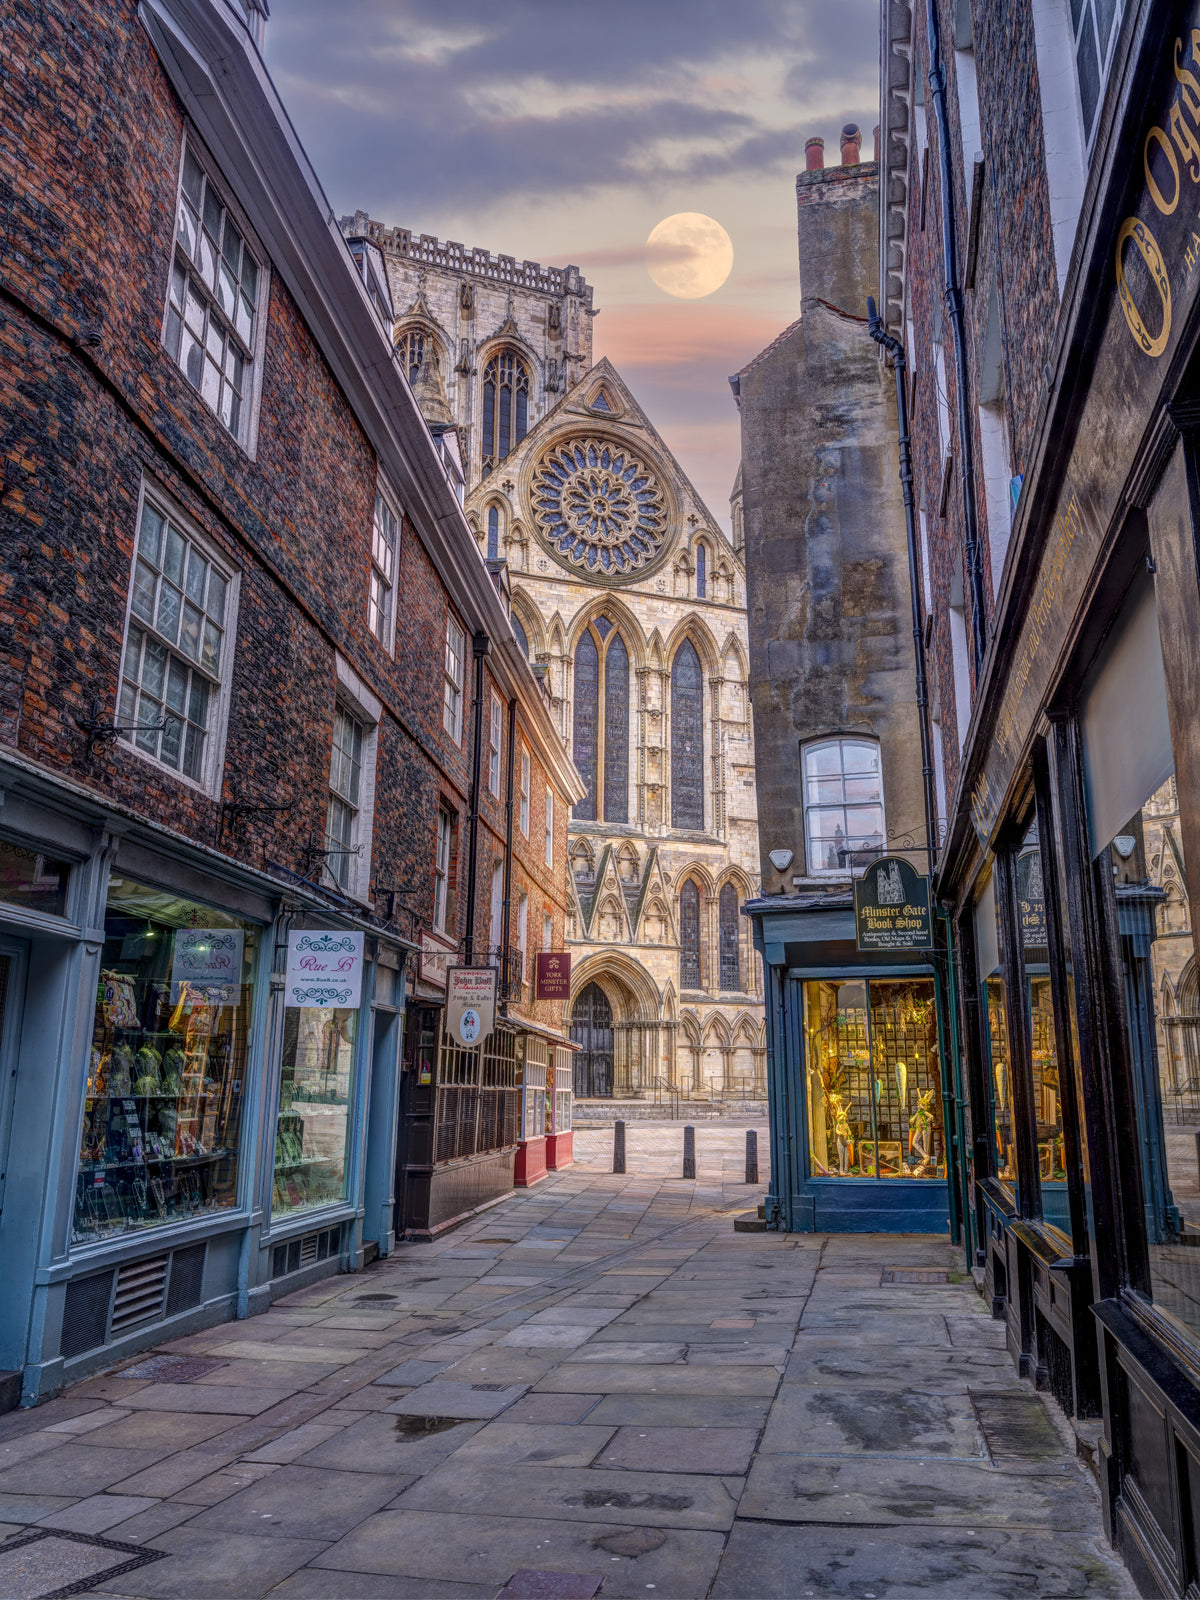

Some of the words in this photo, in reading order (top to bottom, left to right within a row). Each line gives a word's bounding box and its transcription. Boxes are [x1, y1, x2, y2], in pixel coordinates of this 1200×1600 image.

[1144, 28, 1200, 216] Ogd
[1032, 566, 1055, 636] Period
[1027, 614, 1040, 660] and
[860, 905, 900, 918] Minster
[902, 904, 927, 916] Gate
[866, 917, 893, 930] Book
[895, 916, 922, 930] Shop
[291, 955, 329, 972] Rue
[330, 956, 358, 973] B
[453, 976, 473, 986] John
[474, 976, 493, 986] Bull
